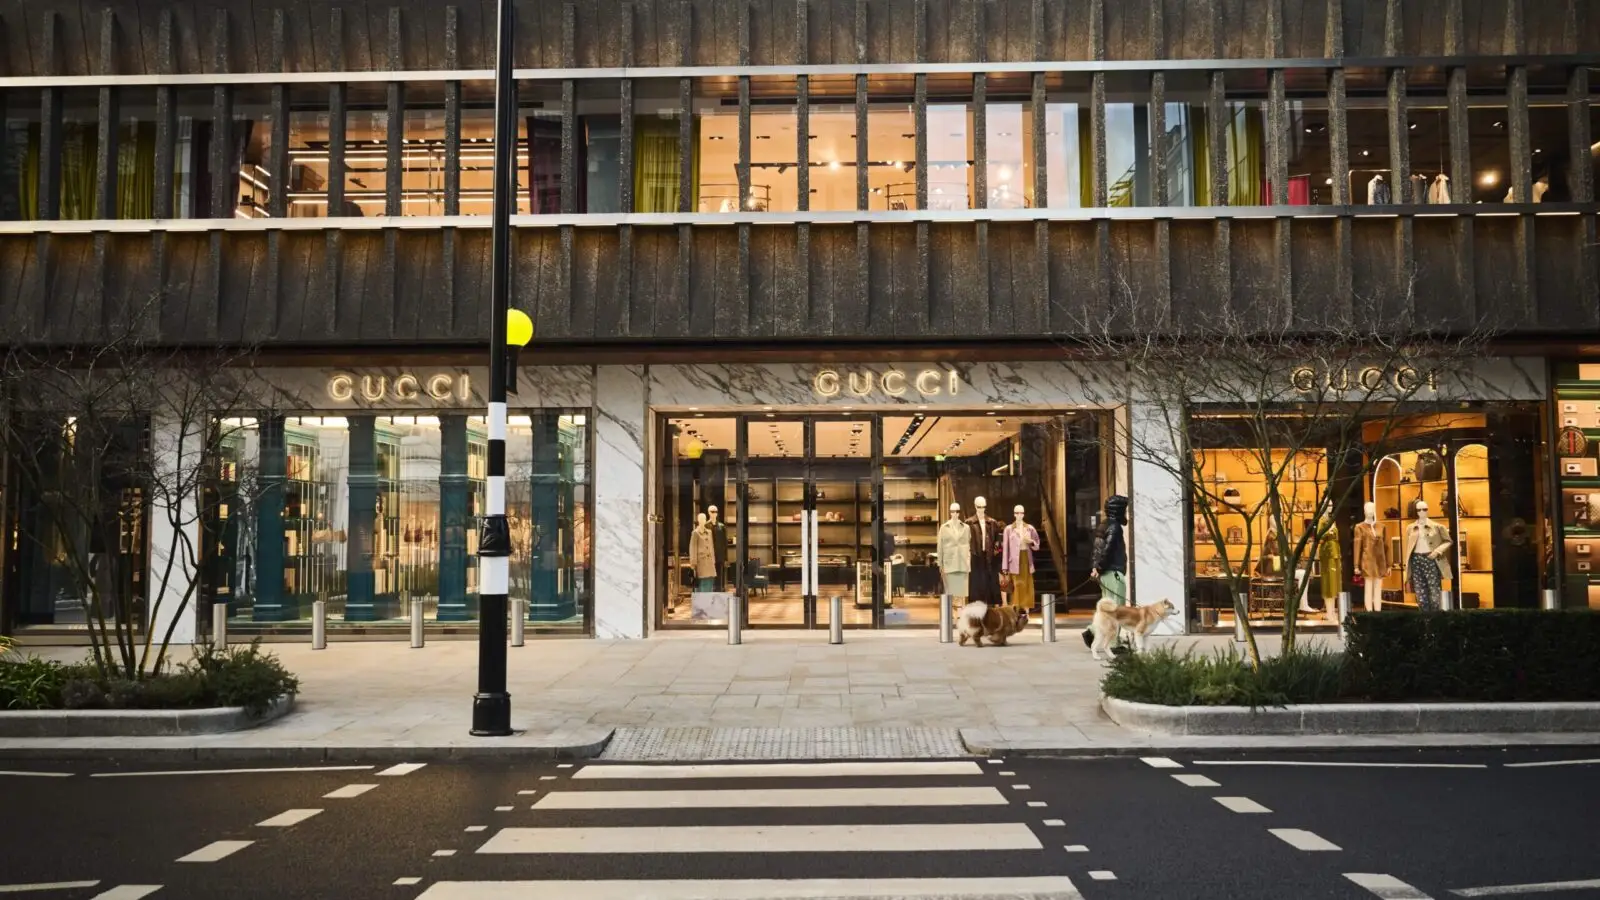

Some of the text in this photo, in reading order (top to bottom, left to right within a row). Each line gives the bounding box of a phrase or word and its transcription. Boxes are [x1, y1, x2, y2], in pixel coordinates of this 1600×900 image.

[327, 374, 470, 401] GUCCI
[814, 369, 959, 397] GUCCI
[1291, 366, 1437, 393] GUCCI
